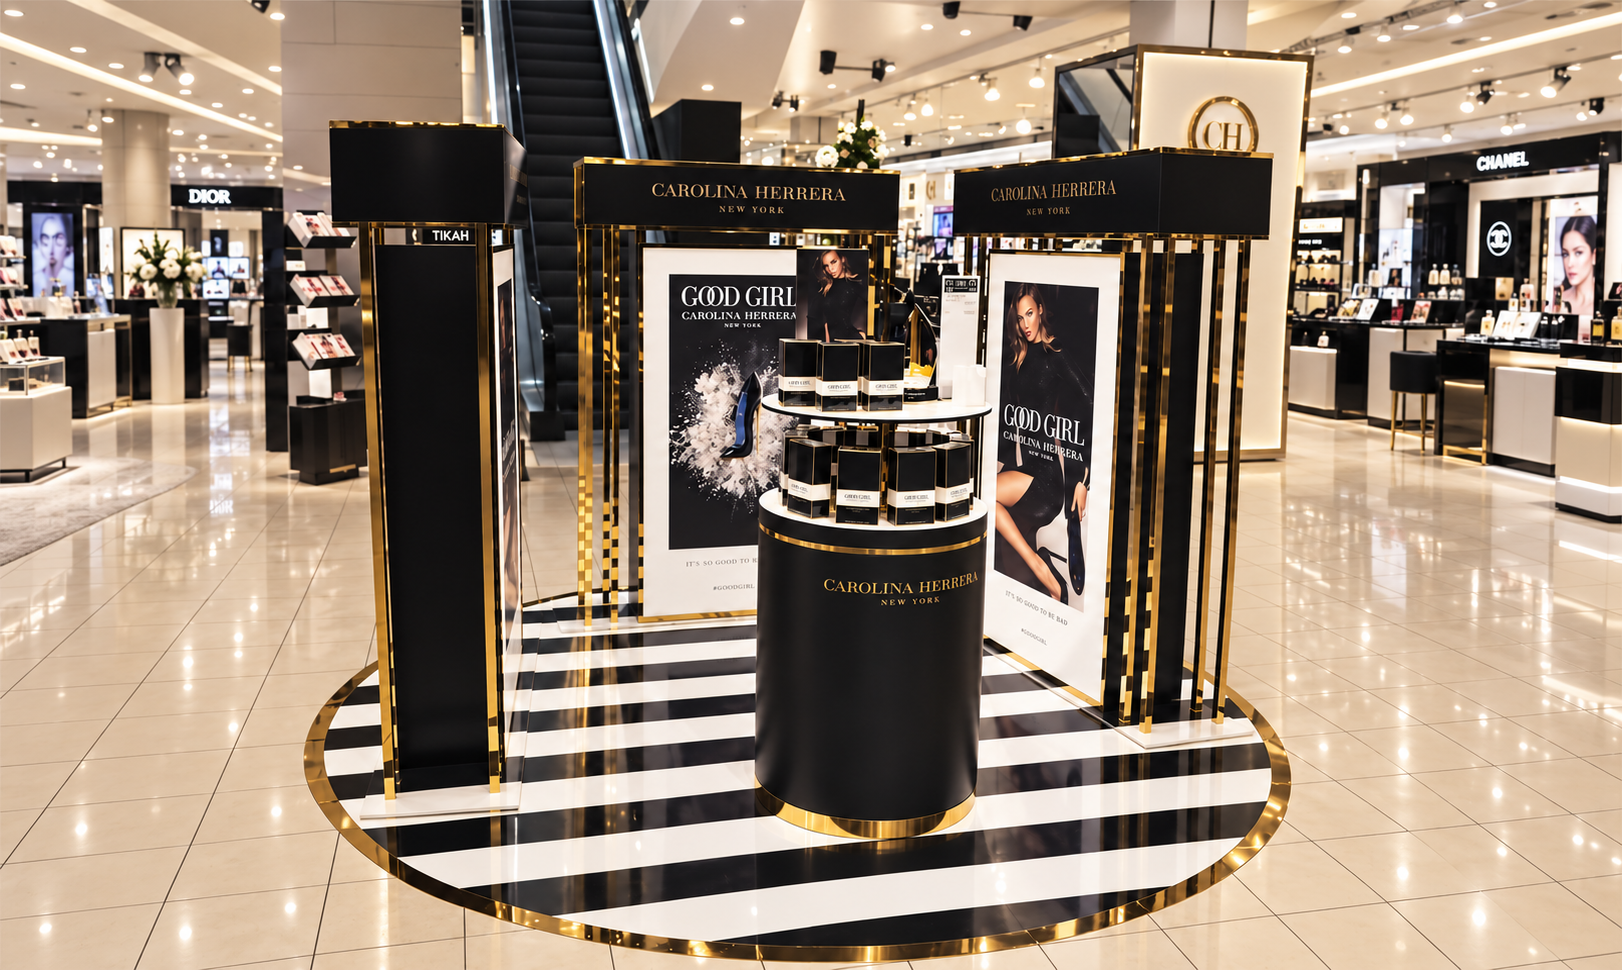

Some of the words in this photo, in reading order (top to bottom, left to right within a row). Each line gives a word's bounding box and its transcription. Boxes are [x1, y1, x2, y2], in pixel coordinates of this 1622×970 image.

[1203, 121, 1243, 151] CH
[1476, 151, 1529, 171] CHANEL
[188, 189, 231, 204] DIOR
[651, 182, 748, 199] CAROLINA
[755, 185, 846, 201] HERRERA
[991, 185, 1048, 202] CAROLINA
[1051, 180, 1116, 198] HERRERA
[719, 205, 745, 213] NEW
[752, 206, 785, 214] YORK
[1027, 208, 1043, 216] NEW
[1048, 206, 1070, 215] YORK
[432, 230, 469, 241] TIKAH
[681, 285, 740, 307] GOOD
[745, 285, 797, 307] GIRL
[681, 311, 741, 320] CAROLINA
[745, 311, 796, 320] HERRERA
[1004, 403, 1041, 433] GOOD
[1043, 413, 1085, 447] GIRL
[823, 578, 914, 595] CAROLINA
[919, 571, 979, 593] HERRERA
[912, 596, 940, 605] YORK
[1040, 607, 1047, 616] TO
